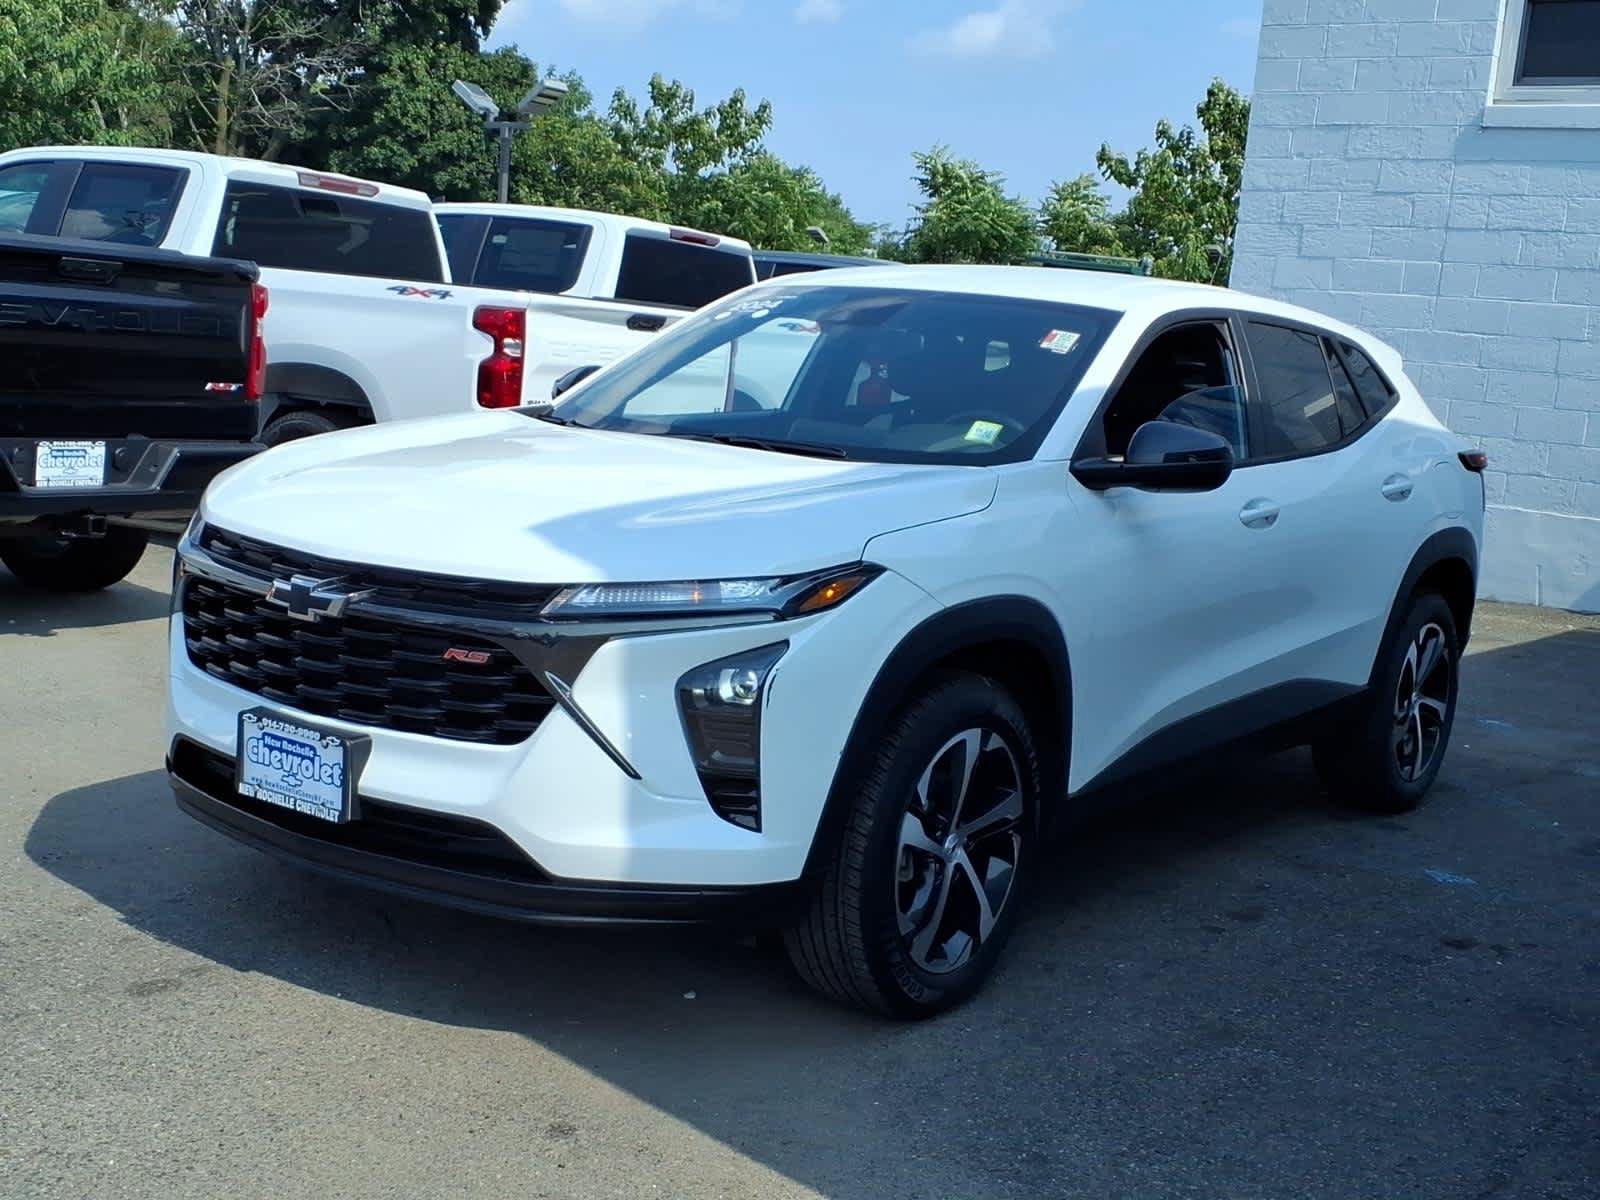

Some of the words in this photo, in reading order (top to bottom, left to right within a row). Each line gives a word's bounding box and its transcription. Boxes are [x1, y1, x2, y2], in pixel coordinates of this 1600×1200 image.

[39, 453, 104, 469] Chevrolet
[443, 647, 491, 664] RS
[247, 736, 344, 789] Chevrolet
